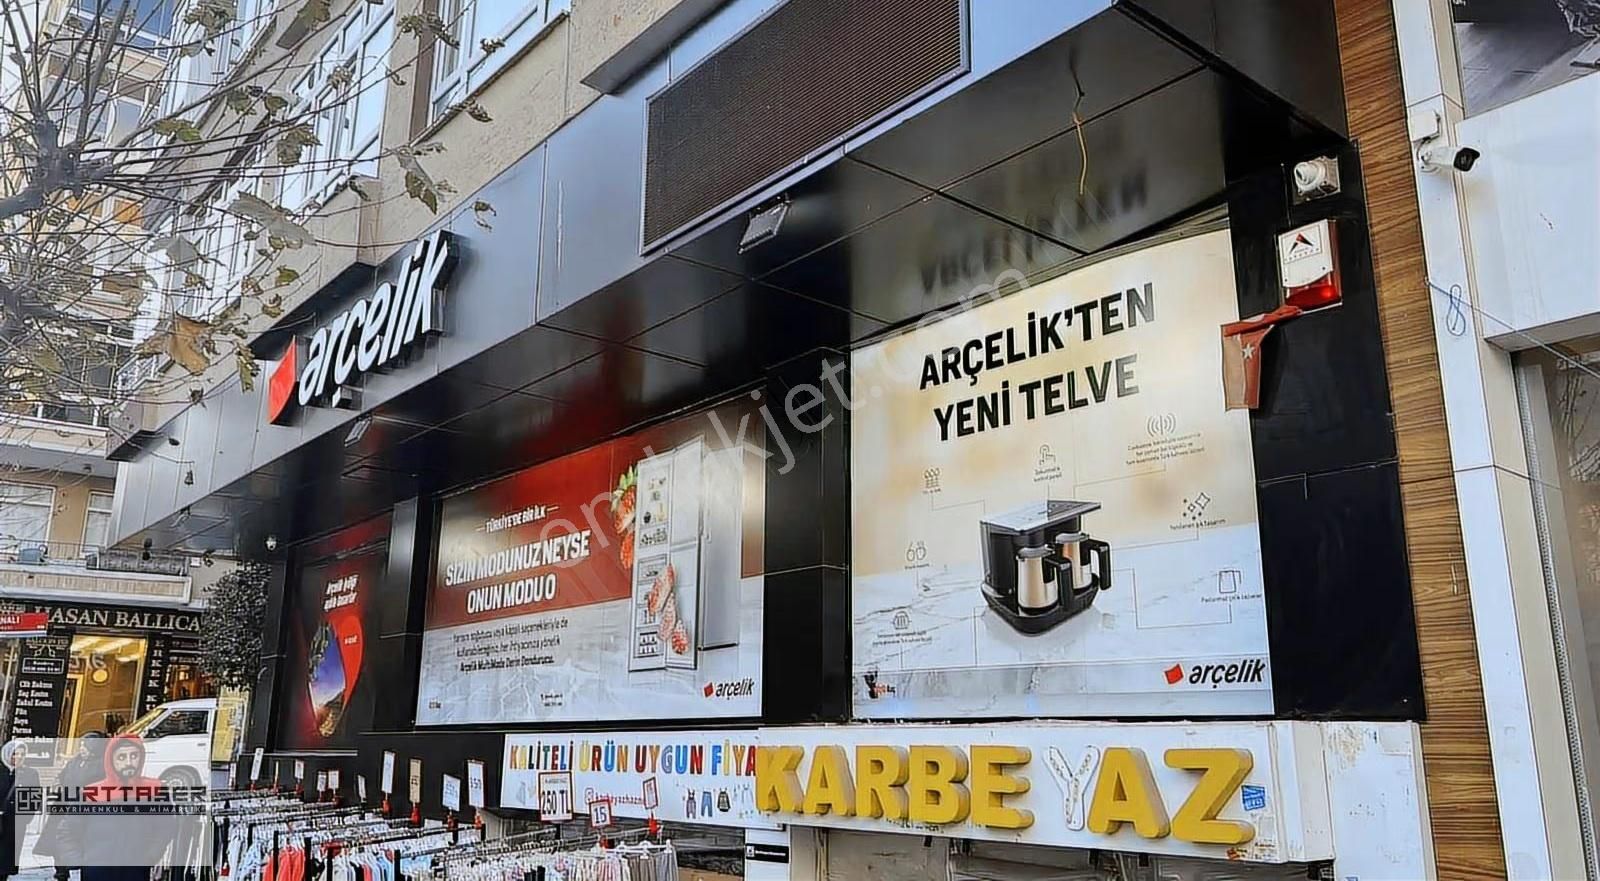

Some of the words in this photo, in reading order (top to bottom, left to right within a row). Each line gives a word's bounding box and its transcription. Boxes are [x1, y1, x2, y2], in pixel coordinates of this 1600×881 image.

[299, 230, 448, 408] arçelik
[919, 282, 1155, 391] ARÇELİK'TEN
[933, 379, 1011, 442] YENİ
[1018, 353, 1140, 420] TELVE
[476, 541, 542, 581] MODUNUZ
[541, 530, 592, 566] NEYSE
[466, 583, 503, 614] ONUN
[502, 576, 544, 608] MODU
[544, 573, 557, 600] O
[715, 677, 755, 701] arçelik
[1188, 658, 1267, 689] arçelik
[509, 741, 574, 771] KALİTELİ
[578, 740, 629, 773] ÜRÜN
[634, 745, 703, 774] UYGUN
[711, 740, 757, 777] FİYA
